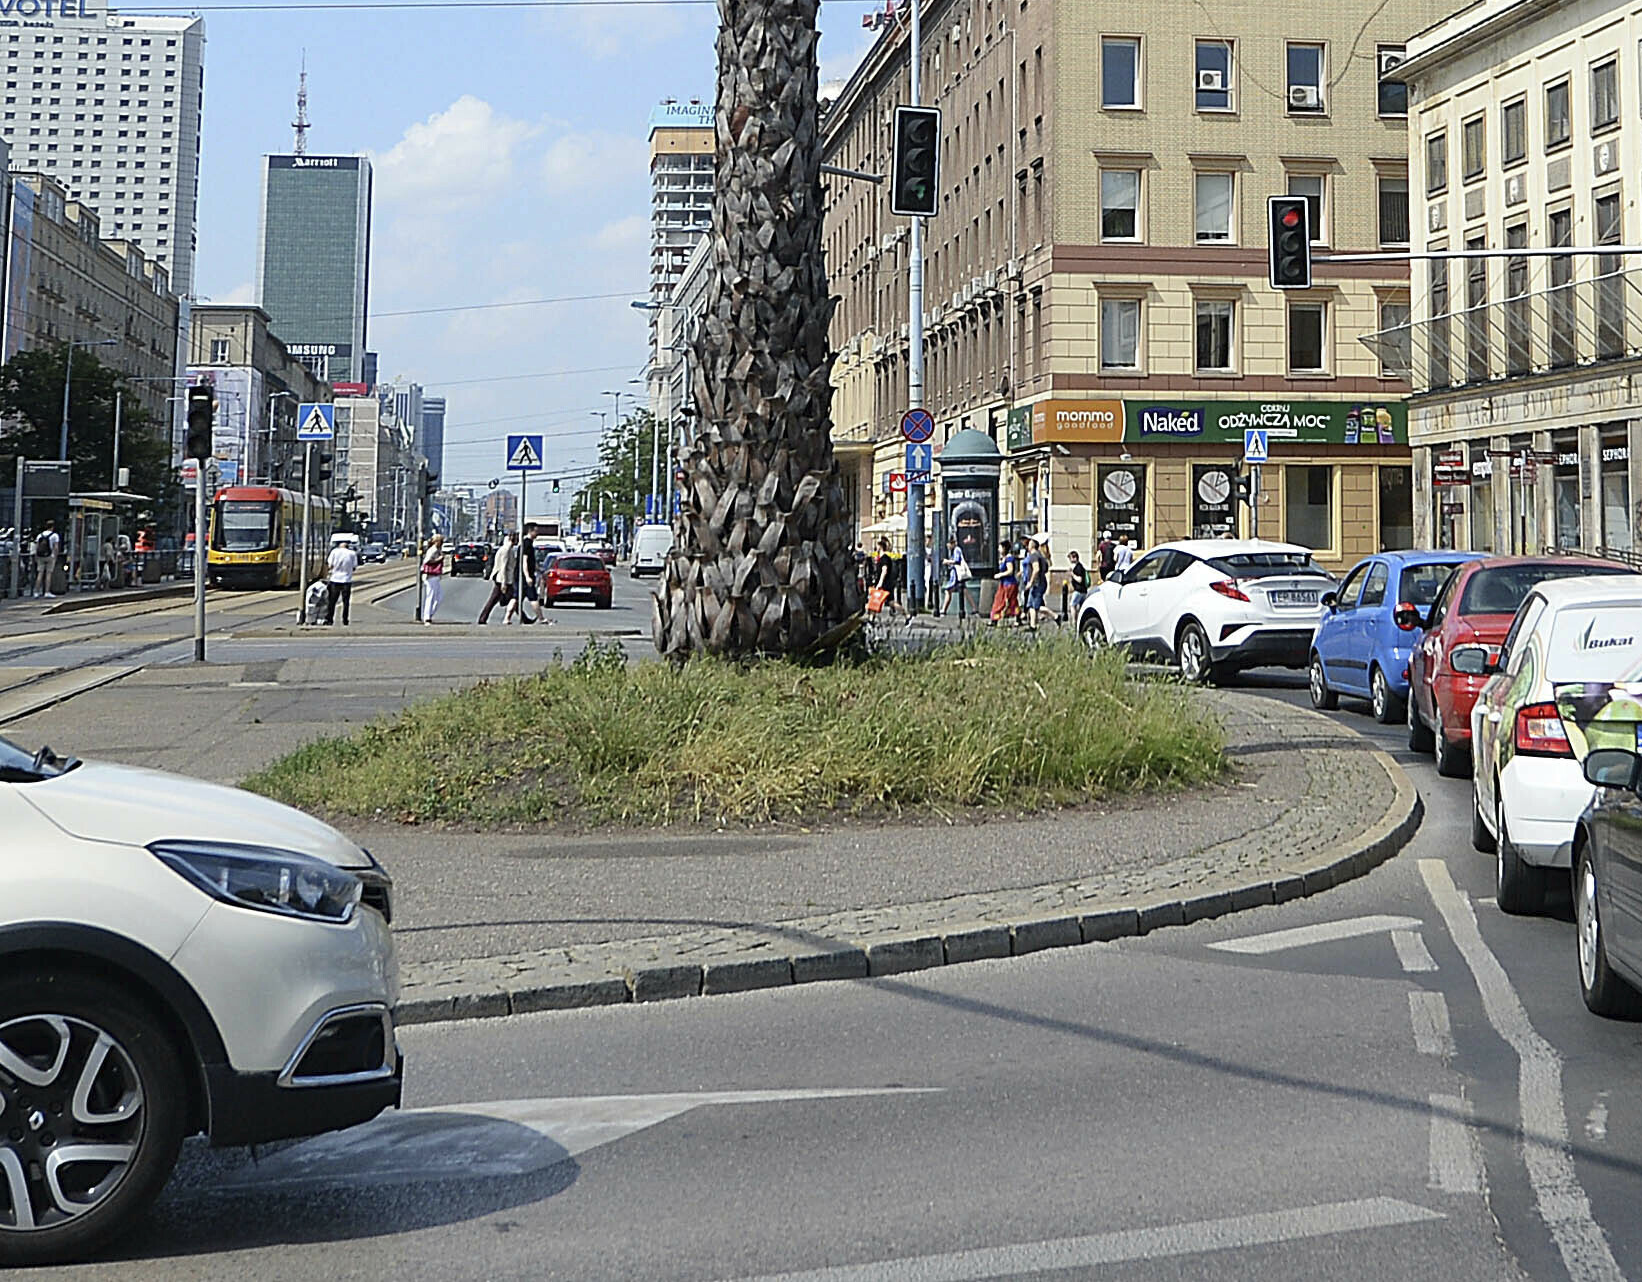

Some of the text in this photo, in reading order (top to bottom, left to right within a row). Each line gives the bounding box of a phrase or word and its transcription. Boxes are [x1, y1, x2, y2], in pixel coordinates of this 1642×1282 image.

[1056, 411, 1114, 422] mommo
[1143, 411, 1201, 432] Naked
[1056, 421, 1114, 430] goodfood
[1602, 447, 1629, 462] SEPHOR
[1588, 636, 1634, 649] Bukat
